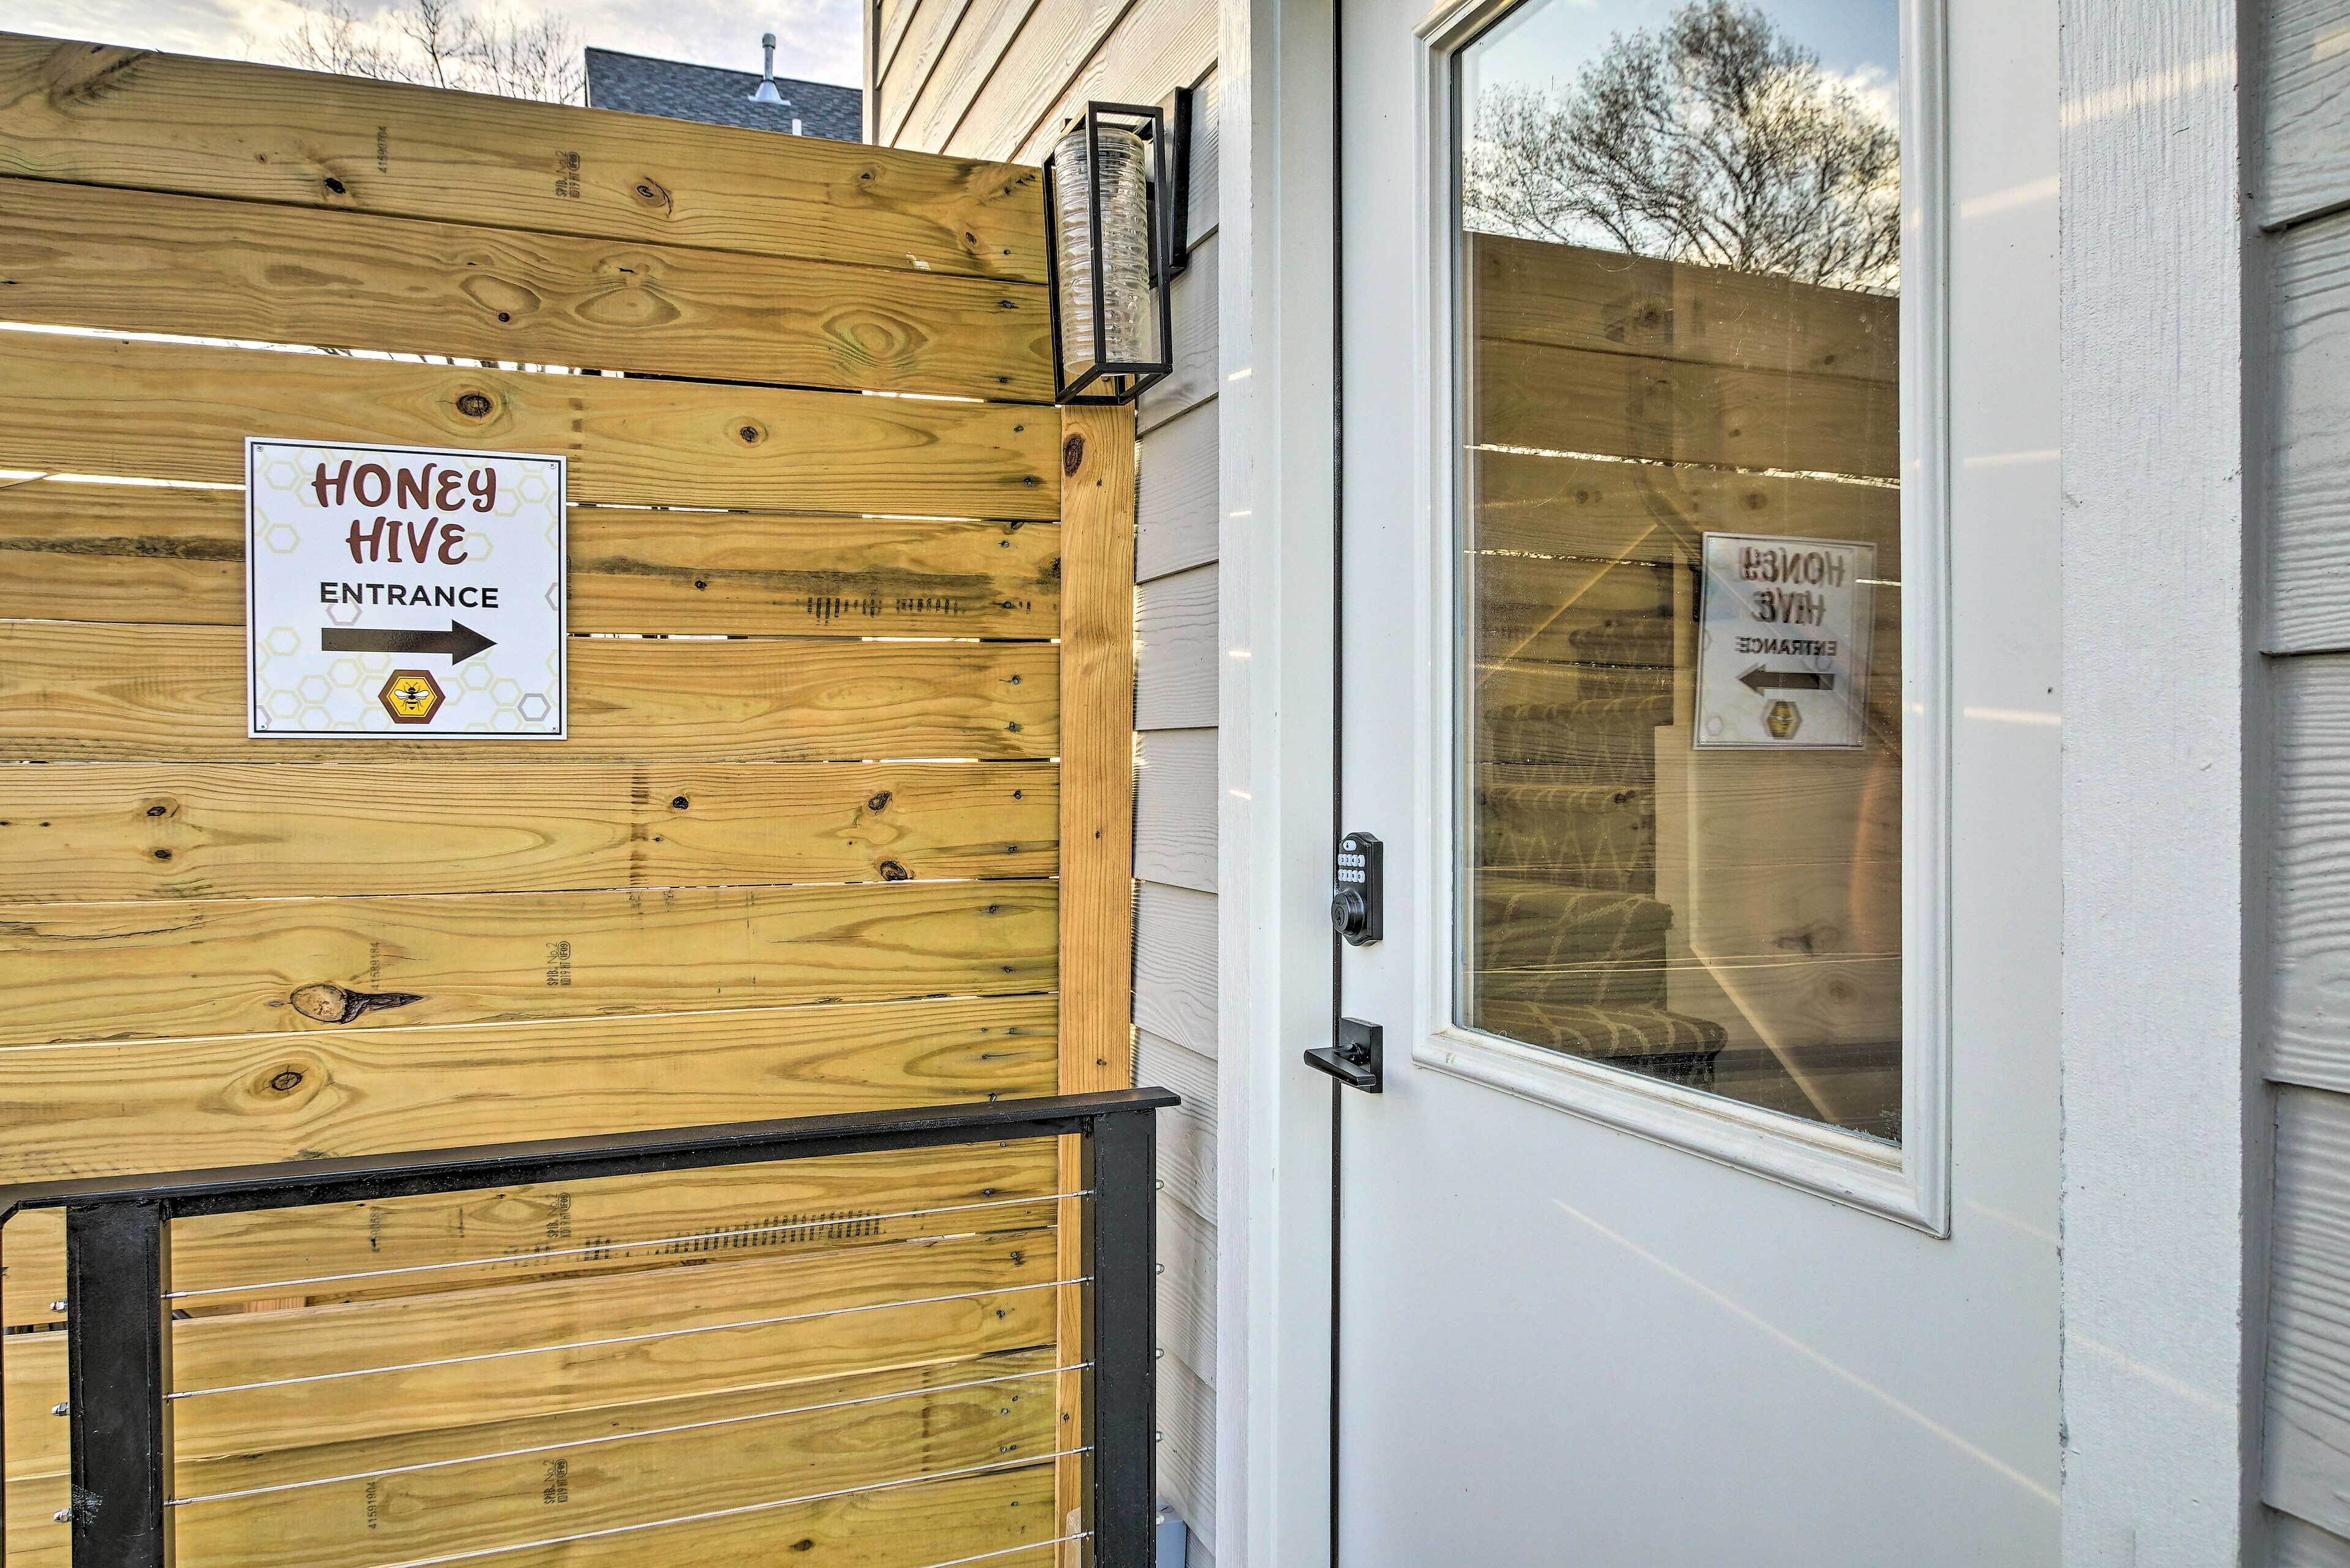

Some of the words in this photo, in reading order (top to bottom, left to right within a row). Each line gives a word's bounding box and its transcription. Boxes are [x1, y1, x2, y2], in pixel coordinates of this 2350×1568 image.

[311, 460, 496, 513] HONEY
[345, 516, 468, 565] HIVE
[320, 581, 499, 609] ENTRANCE
[559, 943, 569, 958] IF09
[366, 1481, 377, 1529] 41591904
